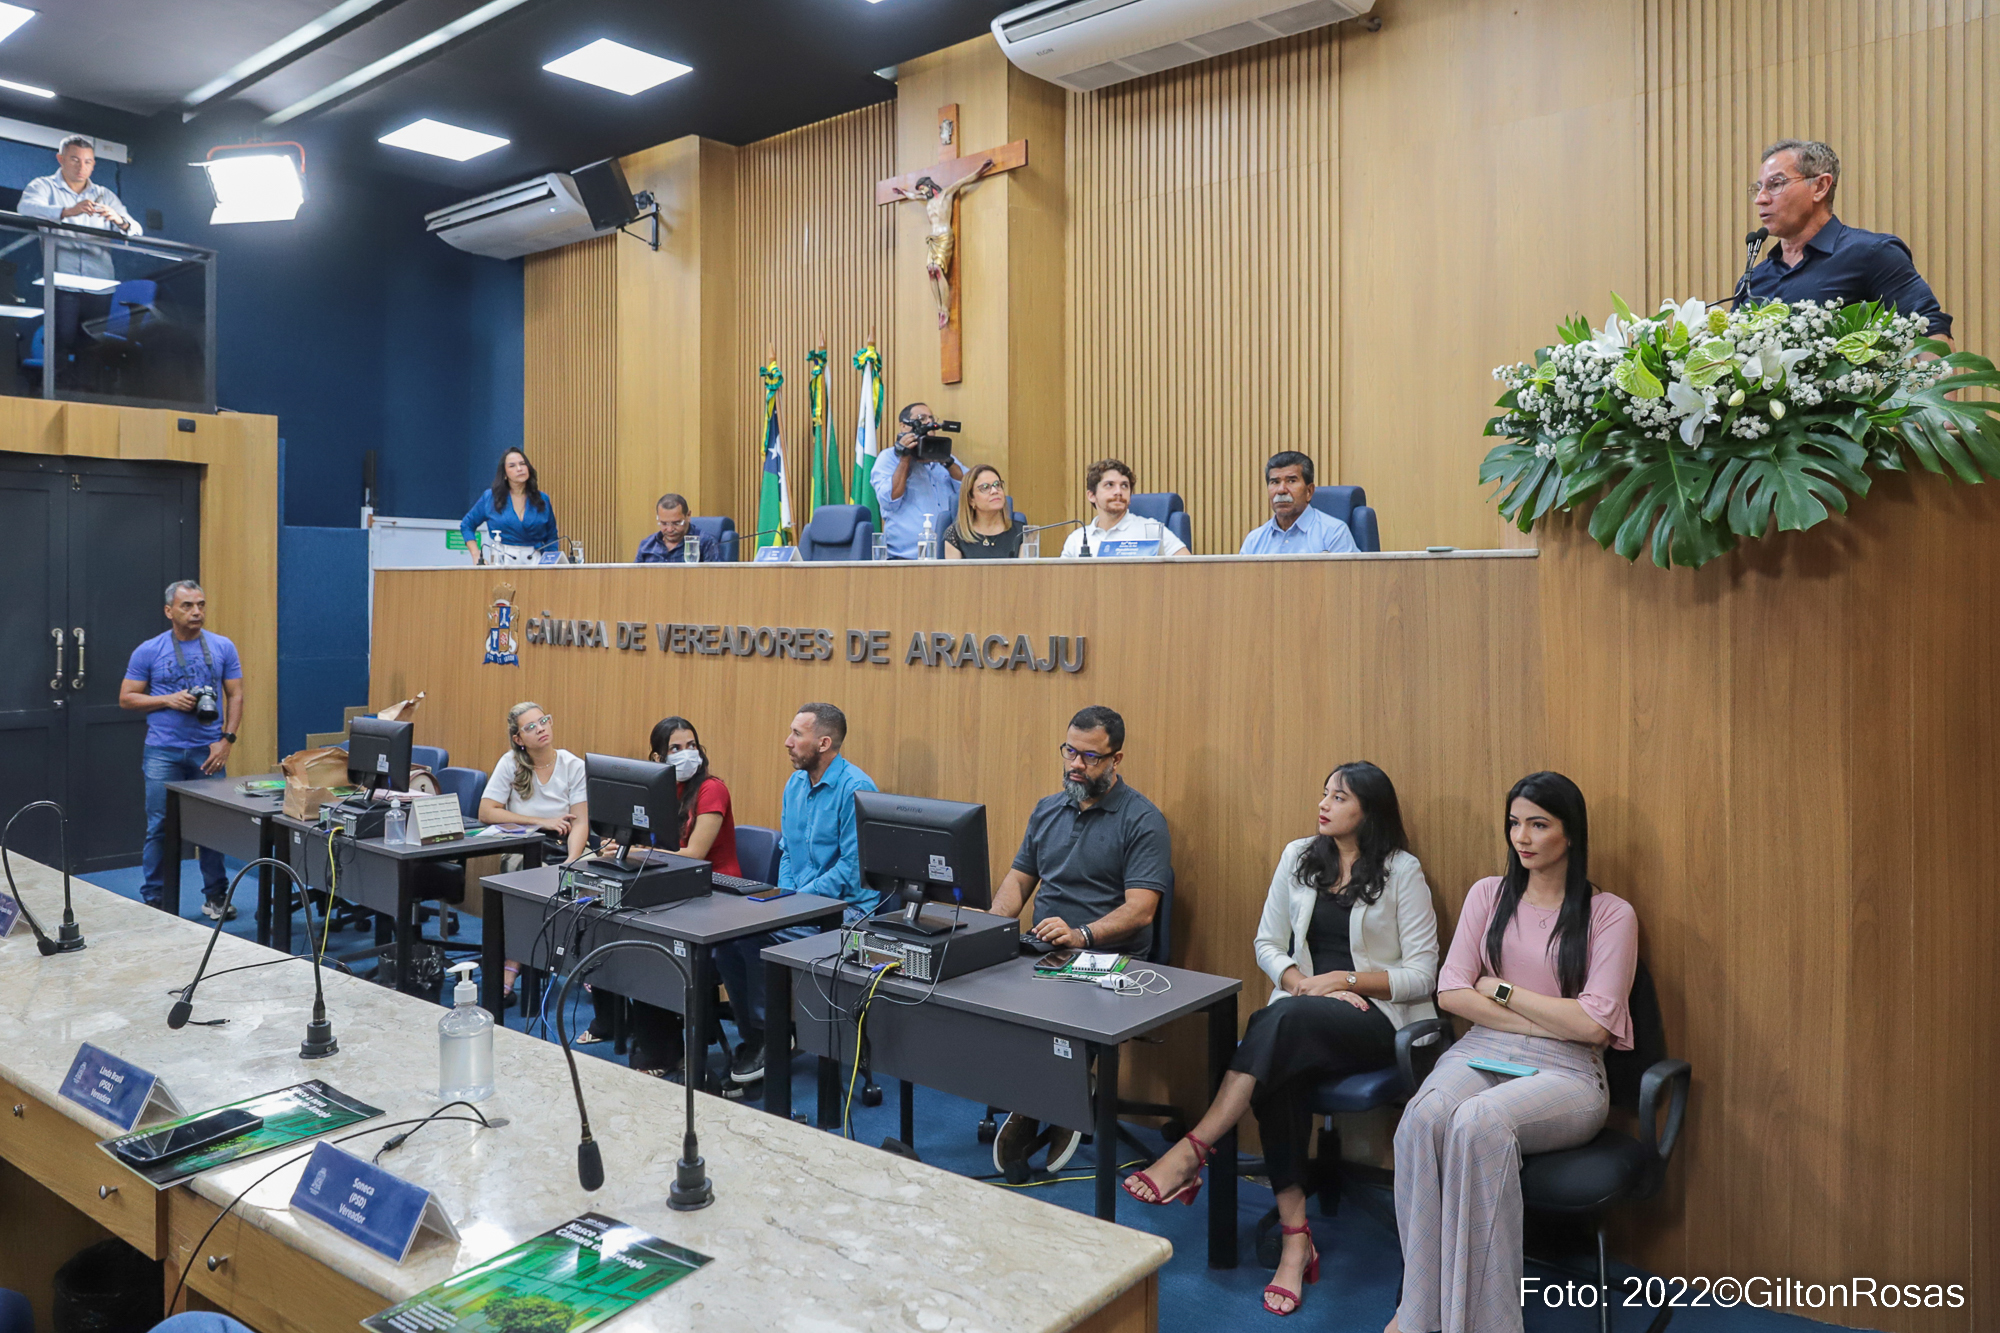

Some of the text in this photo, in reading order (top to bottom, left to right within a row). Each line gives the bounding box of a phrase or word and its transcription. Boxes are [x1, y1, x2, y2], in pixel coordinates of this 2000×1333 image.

[525, 610, 1086, 673] CÂMARA DE VEREADORES DE ARACAJU
[99, 1066, 125, 1084] Linda Brasil
[90, 1088, 111, 1105] Vereadora
[352, 1177, 375, 1196] Soneca
[349, 1192, 367, 1209] (PSD)
[338, 1202, 366, 1224] Vereador
[565, 1222, 597, 1237] Nasce
[610, 1253, 647, 1270] racaju
